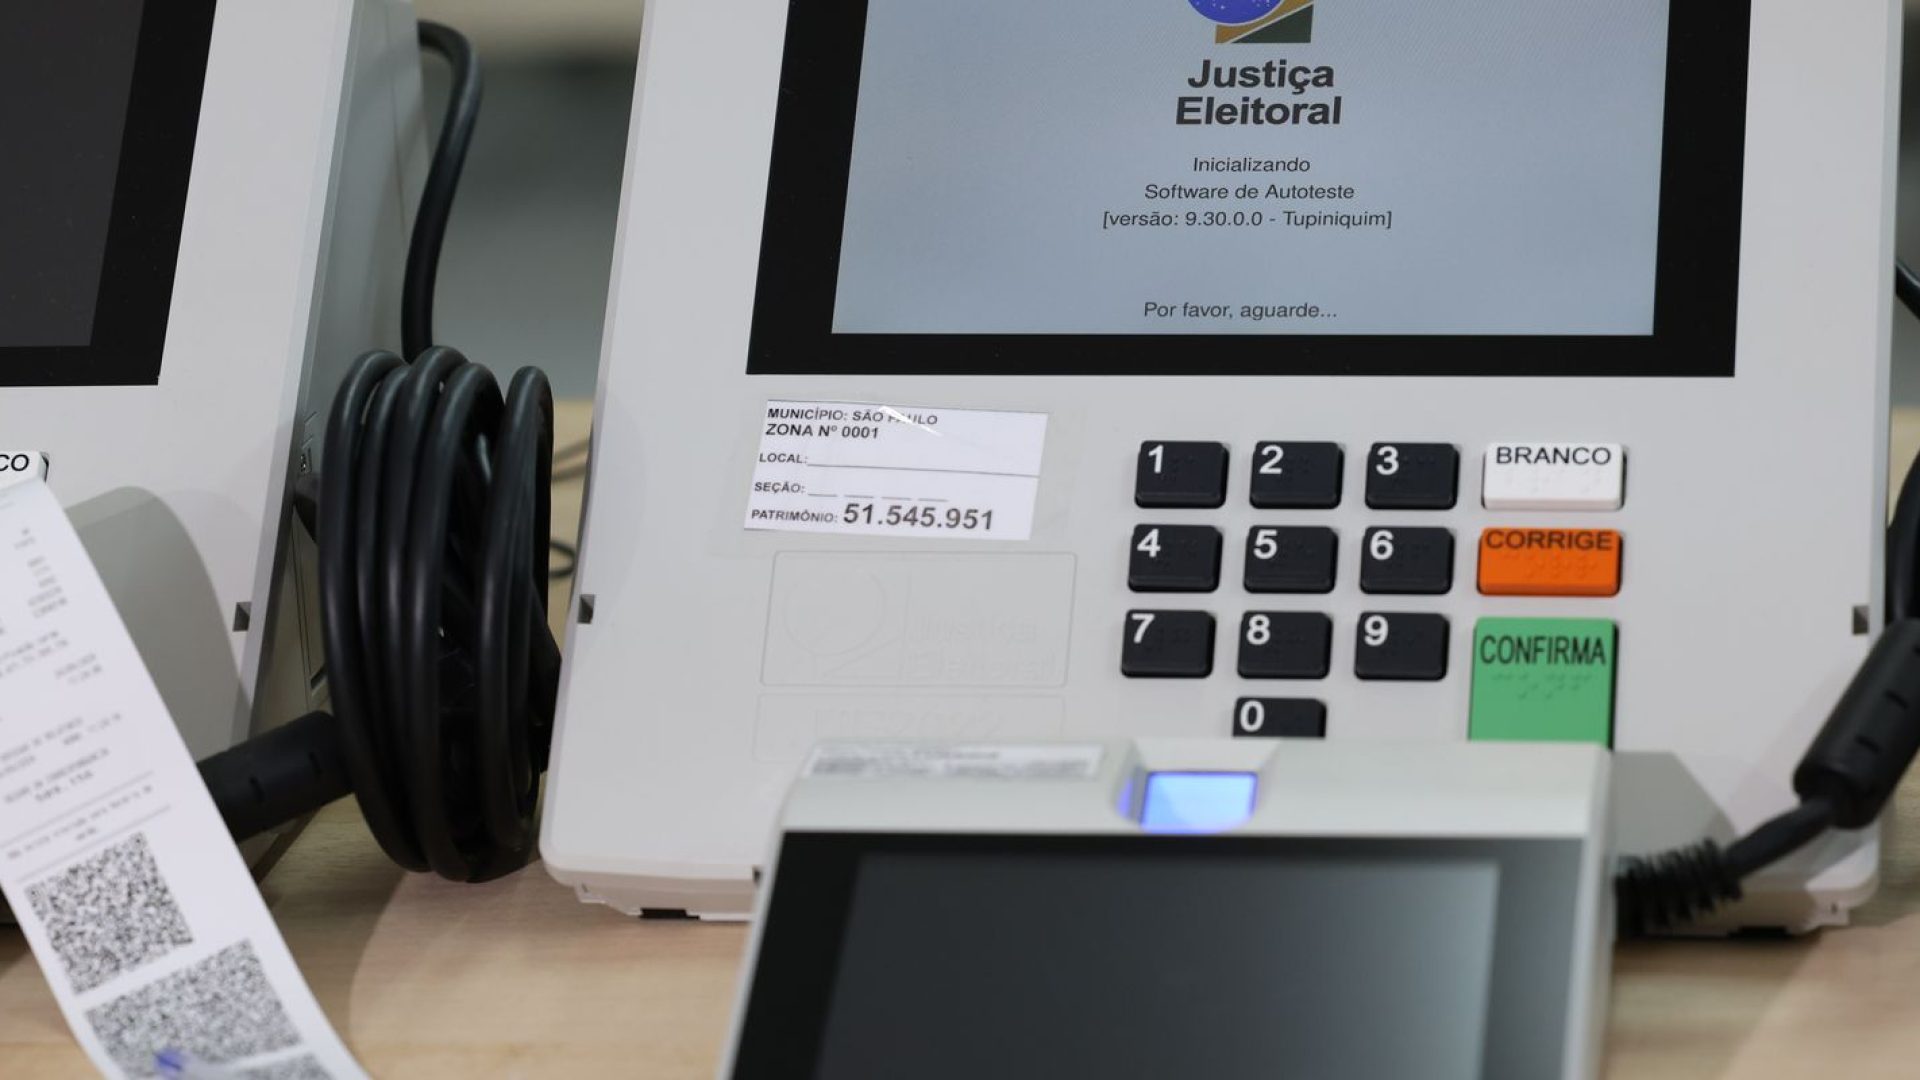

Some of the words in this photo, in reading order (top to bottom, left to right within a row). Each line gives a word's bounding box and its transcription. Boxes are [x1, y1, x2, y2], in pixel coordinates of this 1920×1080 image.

[1188, 59, 1334, 95] Justiça
[1176, 96, 1342, 125] Eleitoral
[1193, 157, 1311, 172] Inicializando
[1144, 184, 1229, 200] Software
[1235, 184, 1259, 200] de
[1265, 184, 1355, 200] Autoteste
[1102, 210, 1179, 229] [versão:
[1185, 211, 1263, 226] 9.30.0.0
[1283, 210, 1393, 230] Tupiniquim]
[1143, 302, 1177, 318] Por
[1182, 302, 1234, 320] favor,
[1240, 302, 1338, 321] aguarde...
[767, 406, 848, 422] MUNICÍPIO:
[852, 408, 884, 423] SÃO
[765, 423, 814, 436] ZONA
[841, 425, 879, 439] 0001
[759, 453, 808, 464] LOCAL:
[1147, 445, 1165, 473] 1
[1259, 445, 1282, 475] 2
[1375, 445, 1400, 475] 3
[1495, 446, 1612, 466] BRANCO
[754, 481, 805, 494] SEÇÃO:
[751, 508, 838, 524] PATRIMÔNIO:
[843, 503, 994, 530] 51.545.951
[1137, 529, 1161, 558] 4
[1253, 530, 1278, 560] 5
[1369, 530, 1394, 560] 6
[1485, 530, 1613, 551] CORRIGE
[1131, 614, 1155, 643] 7
[1246, 615, 1271, 645] 8
[1364, 616, 1389, 646] 9
[1480, 635, 1607, 666] CONFIRMA
[1239, 701, 1265, 732] 0
